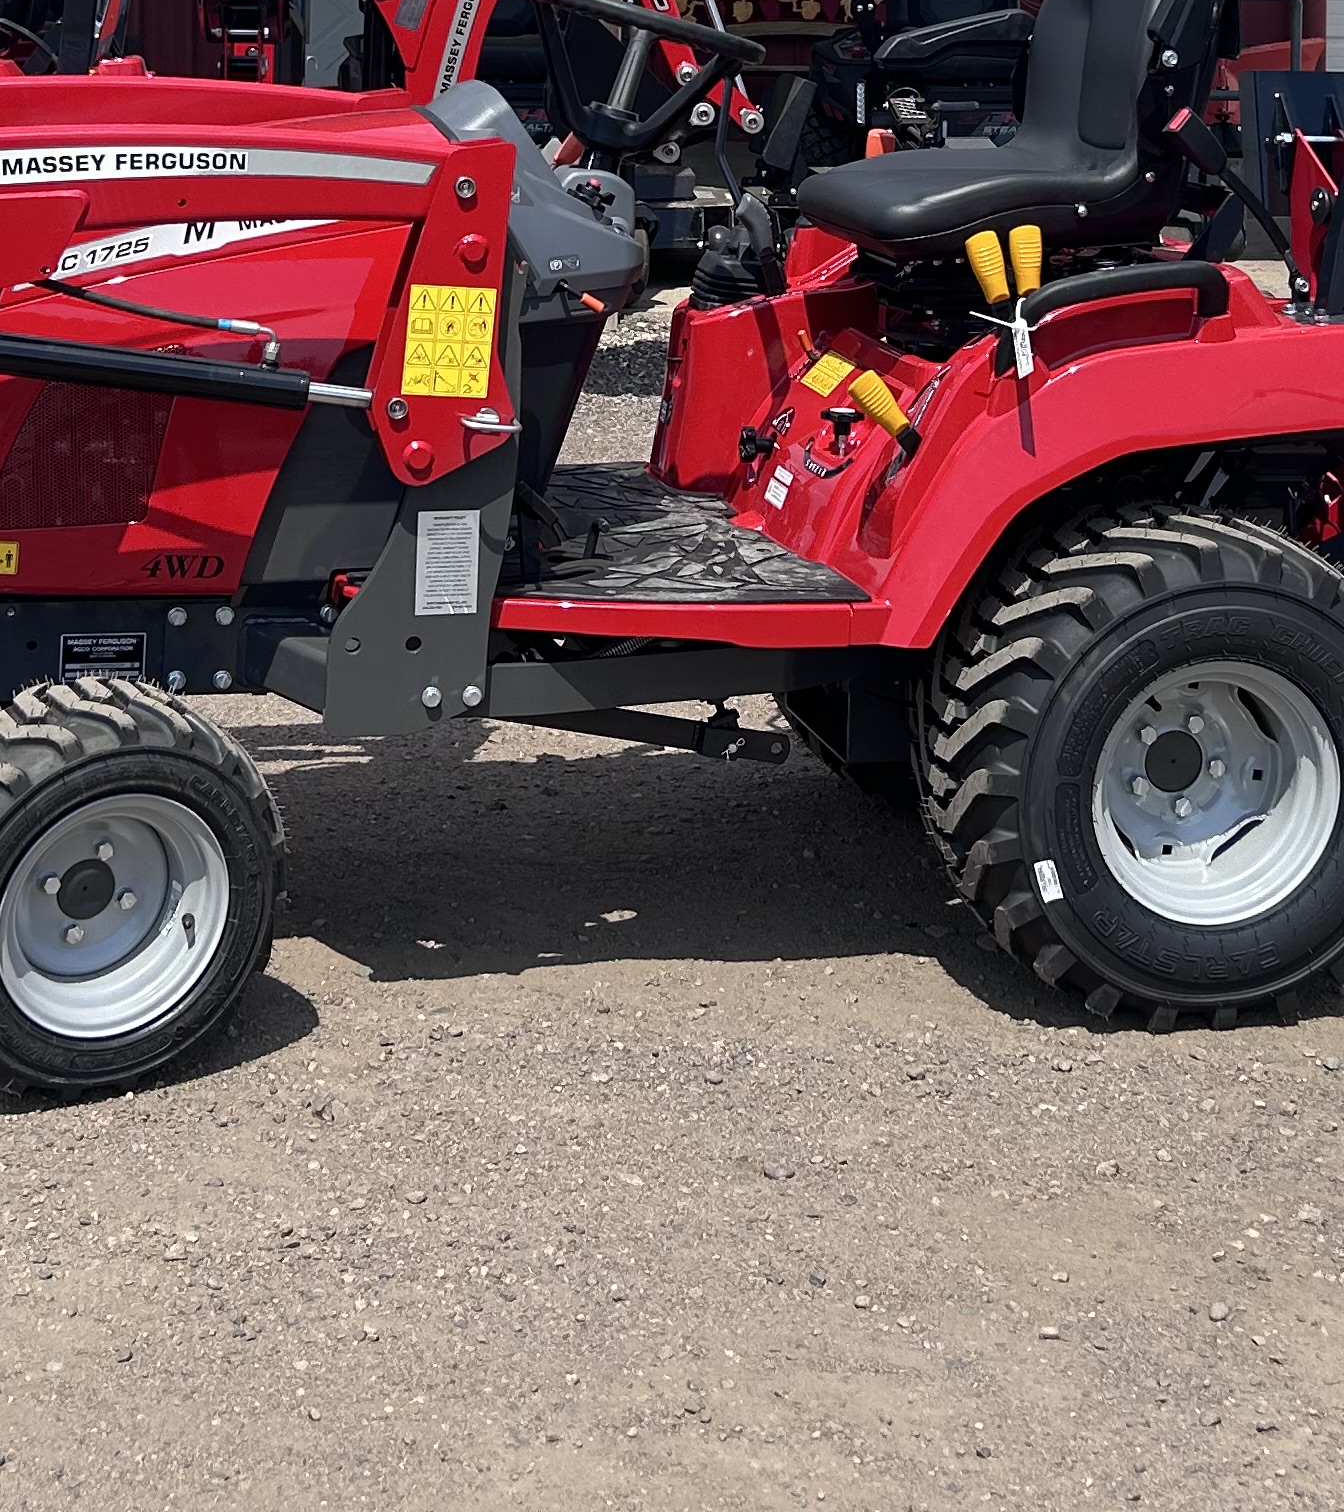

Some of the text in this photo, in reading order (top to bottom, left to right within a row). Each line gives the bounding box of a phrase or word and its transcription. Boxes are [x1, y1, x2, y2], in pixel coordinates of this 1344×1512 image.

[439, 38, 461, 94] MASSEY
[1, 152, 248, 176] MASSEY FERGUSON
[140, 553, 225, 579] 4WD
[1159, 615, 1251, 650] TRAC
